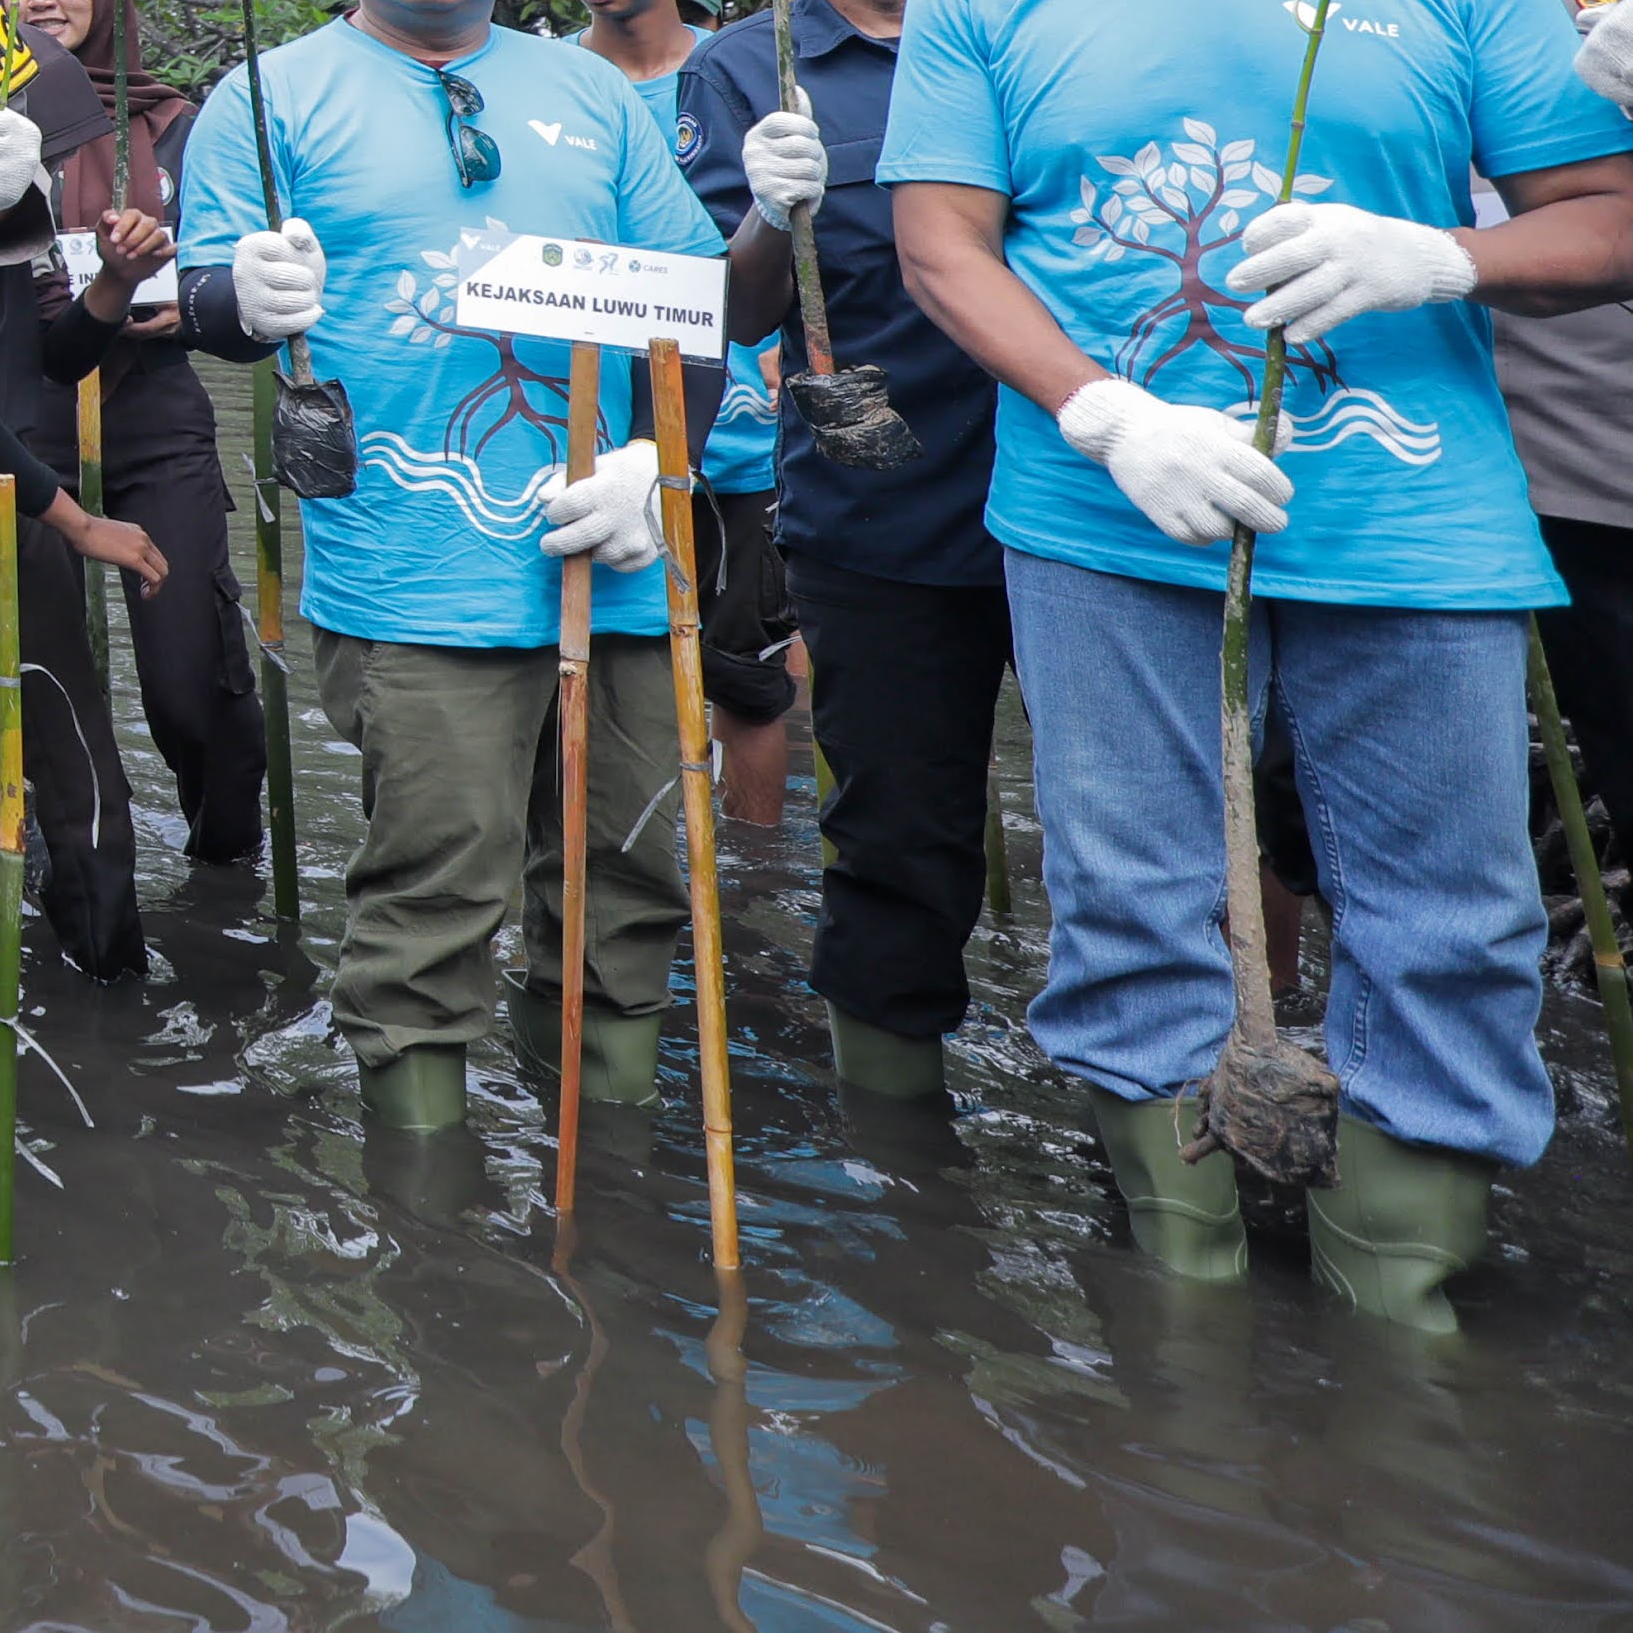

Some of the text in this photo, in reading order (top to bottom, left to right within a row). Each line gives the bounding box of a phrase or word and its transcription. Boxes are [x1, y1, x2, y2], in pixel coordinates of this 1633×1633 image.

[1341, 17, 1400, 38] VALE
[564, 135, 597, 151] VALE
[466, 281, 714, 328] KEJAKSAAN LUWU TIMUR
